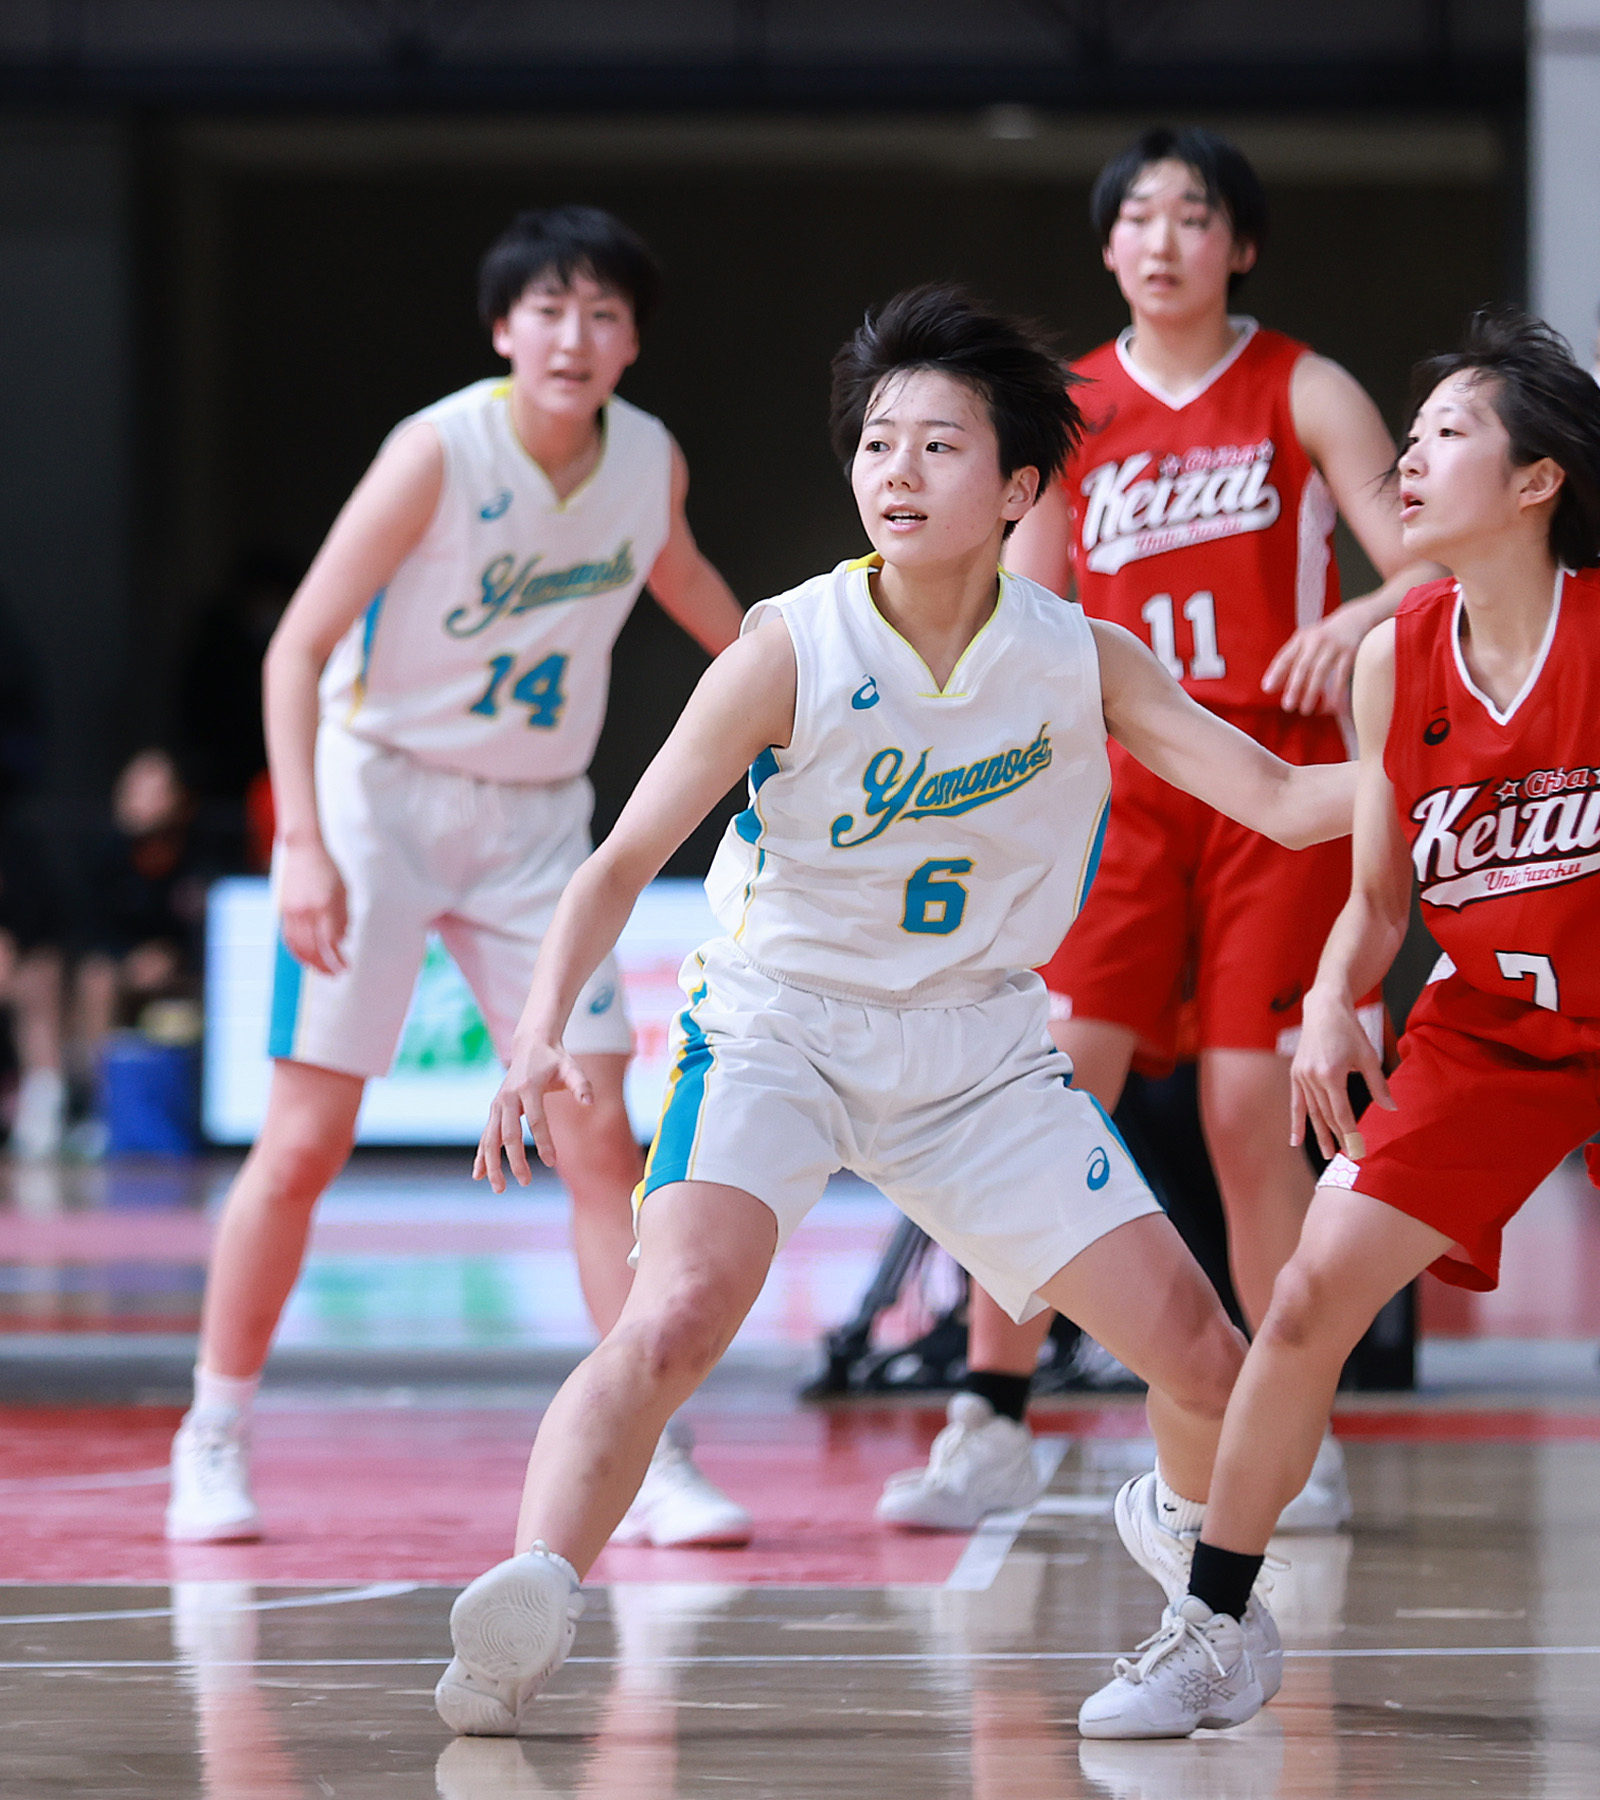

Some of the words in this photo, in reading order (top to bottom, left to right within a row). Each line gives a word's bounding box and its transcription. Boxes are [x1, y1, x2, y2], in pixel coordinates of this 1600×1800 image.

[1081, 451, 1275, 551] Keizai
[1141, 590, 1226, 681] 11
[469, 653, 569, 729] 14
[898, 856, 977, 936] 6
[1494, 950, 1560, 1012] 7
